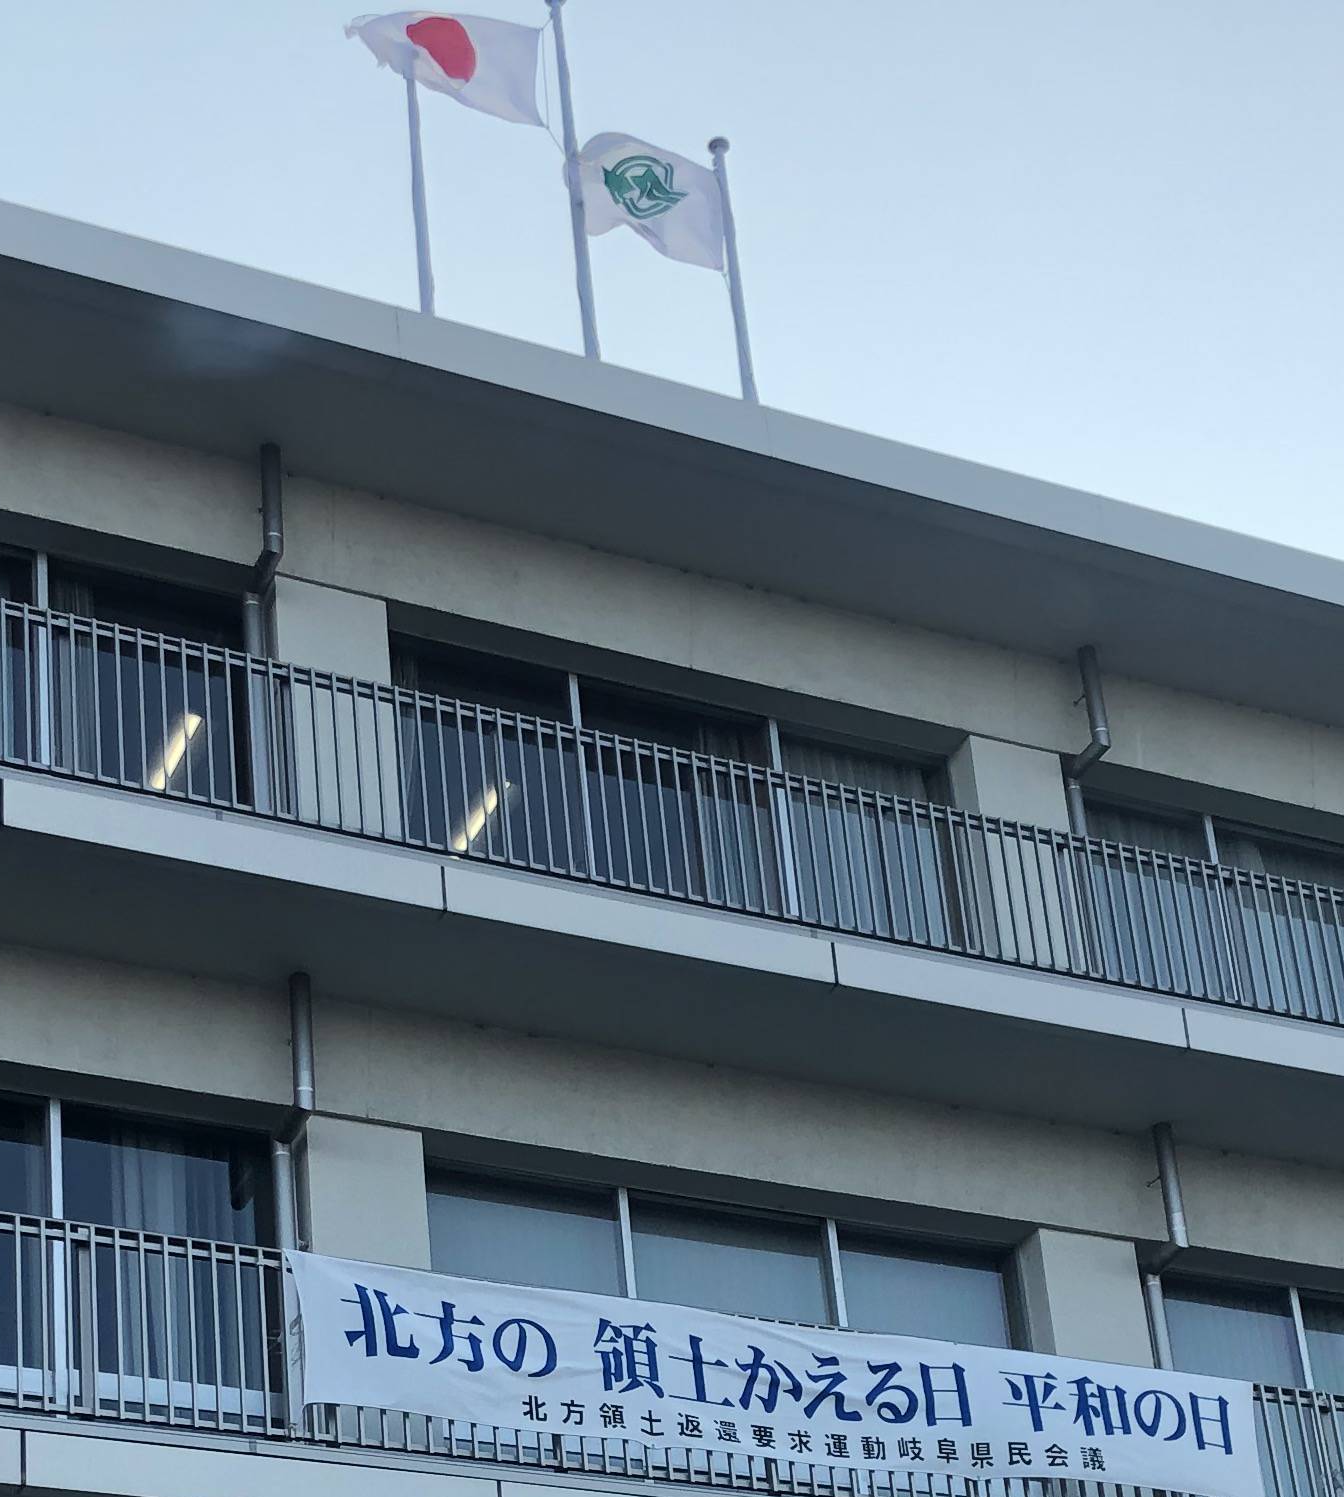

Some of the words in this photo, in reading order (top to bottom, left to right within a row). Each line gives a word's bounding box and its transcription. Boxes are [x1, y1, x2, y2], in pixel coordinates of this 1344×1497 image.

[341, 1282, 558, 1380] 北方の
[595, 1316, 972, 1429] 領土かえる日
[1003, 1371, 1235, 1457] 平和の日
[522, 1395, 1106, 1471] 北方領土返還要求運動岐阜県民会議
